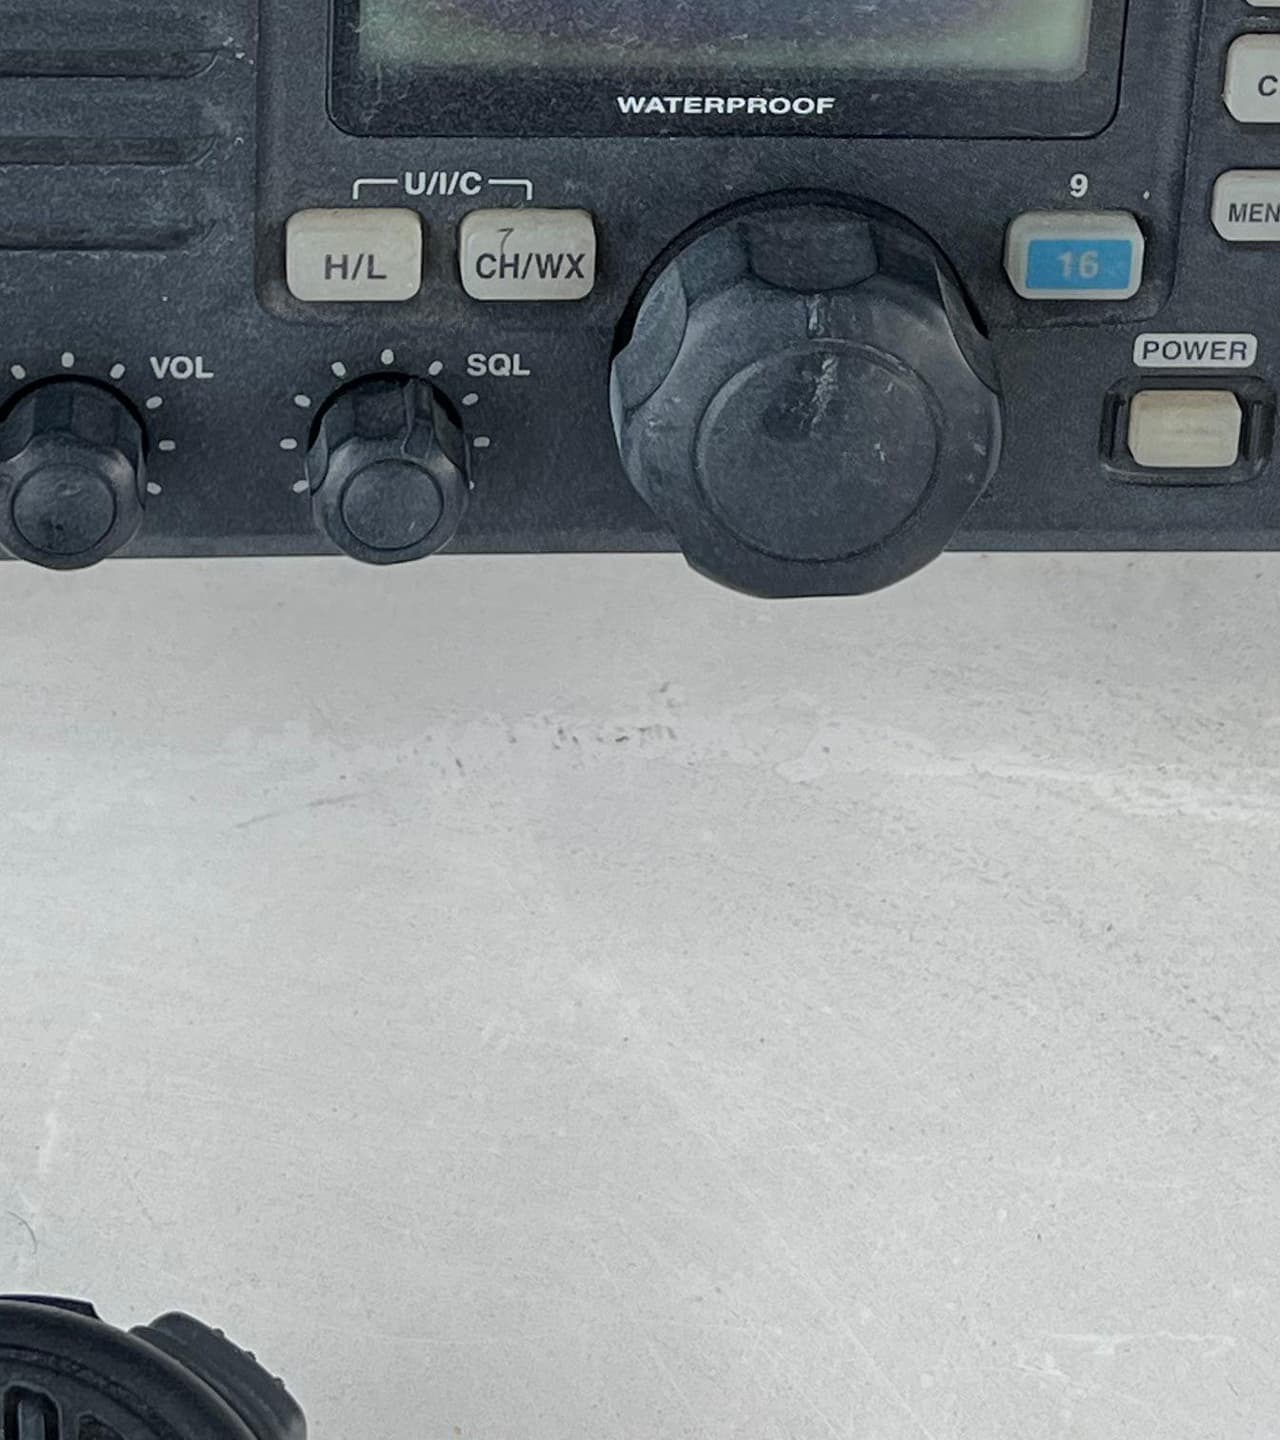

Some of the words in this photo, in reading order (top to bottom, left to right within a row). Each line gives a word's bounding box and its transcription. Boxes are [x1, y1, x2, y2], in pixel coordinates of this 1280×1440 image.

[616, 95, 836, 116] WATERPROOF
[403, 170, 484, 198] U/I/C
[1069, 173, 1090, 200] 9
[323, 253, 388, 282] H/L
[475, 252, 586, 280] CH/WX
[1057, 249, 1100, 279] 16
[1141, 339, 1248, 362] POWER
[149, 356, 214, 379] VOL
[467, 354, 531, 378] SQL
